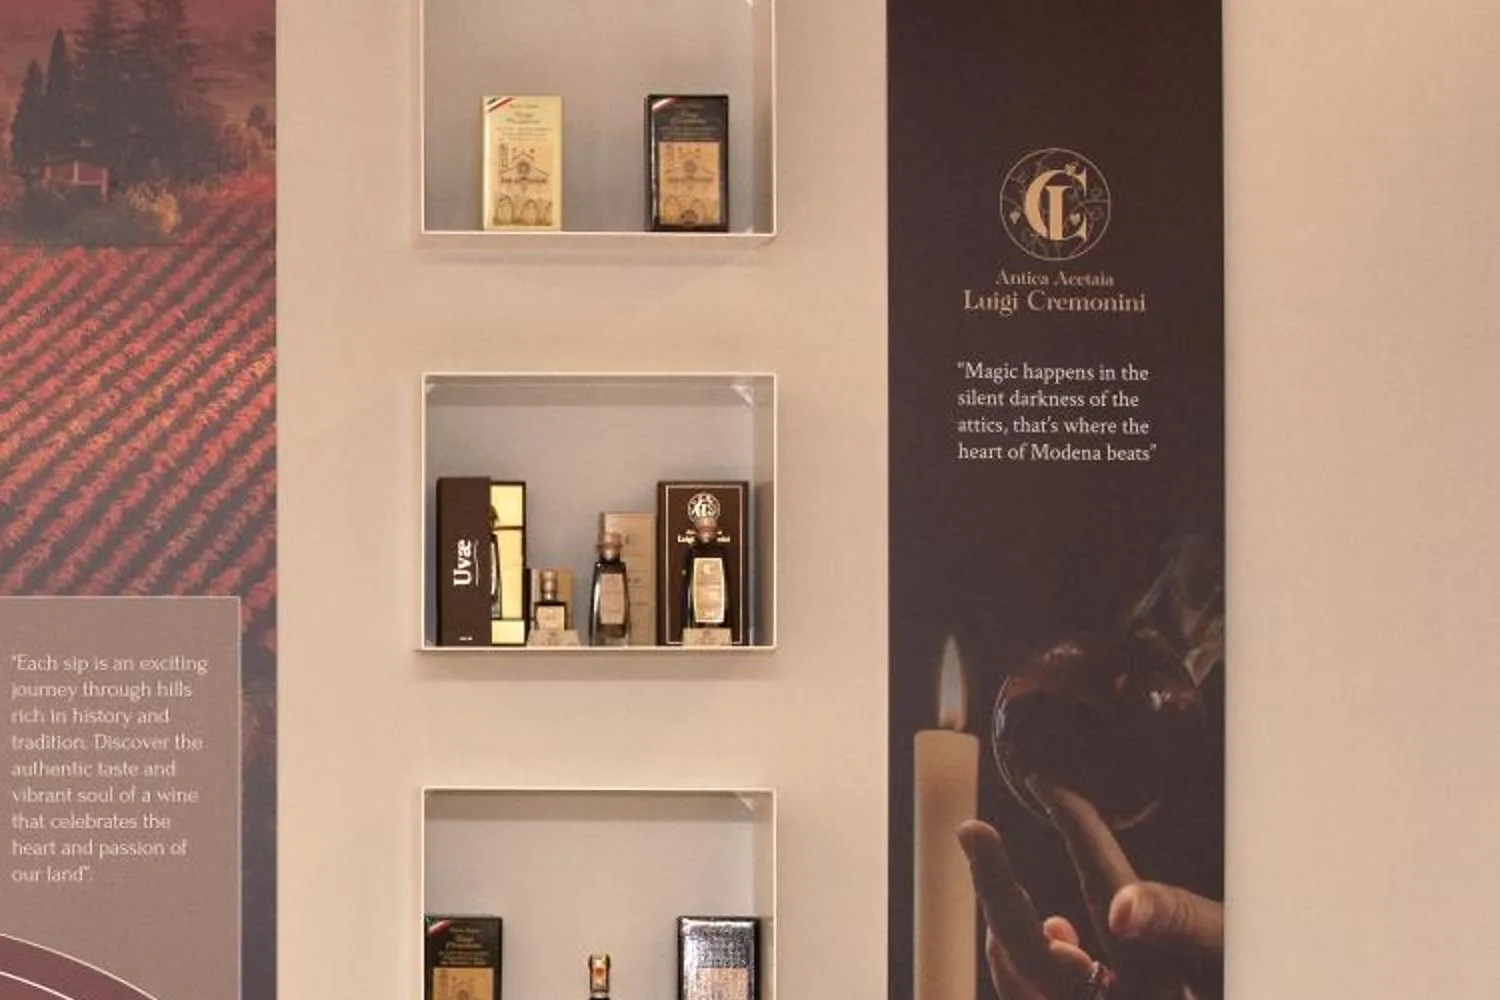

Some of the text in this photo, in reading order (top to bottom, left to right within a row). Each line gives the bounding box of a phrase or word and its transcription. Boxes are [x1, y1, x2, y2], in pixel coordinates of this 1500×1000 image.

[995, 269, 1114, 287] Antica Acetaia
[963, 289, 1146, 316] Luigi Cremonini
[1023, 362, 1095, 384] happens
[1099, 364, 1116, 380] in
[1121, 363, 1149, 381] the
[957, 389, 1139, 407] silent darkness of the
[957, 417, 1008, 435] attics,
[1064, 418, 1116, 434] where
[1122, 418, 1149, 435] the
[958, 442, 1003, 459] heart
[1008, 443, 1028, 460] of
[1031, 443, 1101, 461] Modena
[63, 656, 88, 674] sip
[94, 657, 108, 671] is
[112, 658, 134, 670] an
[139, 655, 209, 675] exciting
[11, 680, 193, 702] journey through hills
[11, 708, 170, 728] rich in history and
[11, 733, 203, 750] tradition. Discover the
[11, 760, 176, 777] authentic taste and
[11, 786, 199, 803] vibrant soul of a wine
[11, 813, 171, 829] that celebrates the
[11, 839, 188, 859] heart and passion of
[11, 868, 41, 882] our
